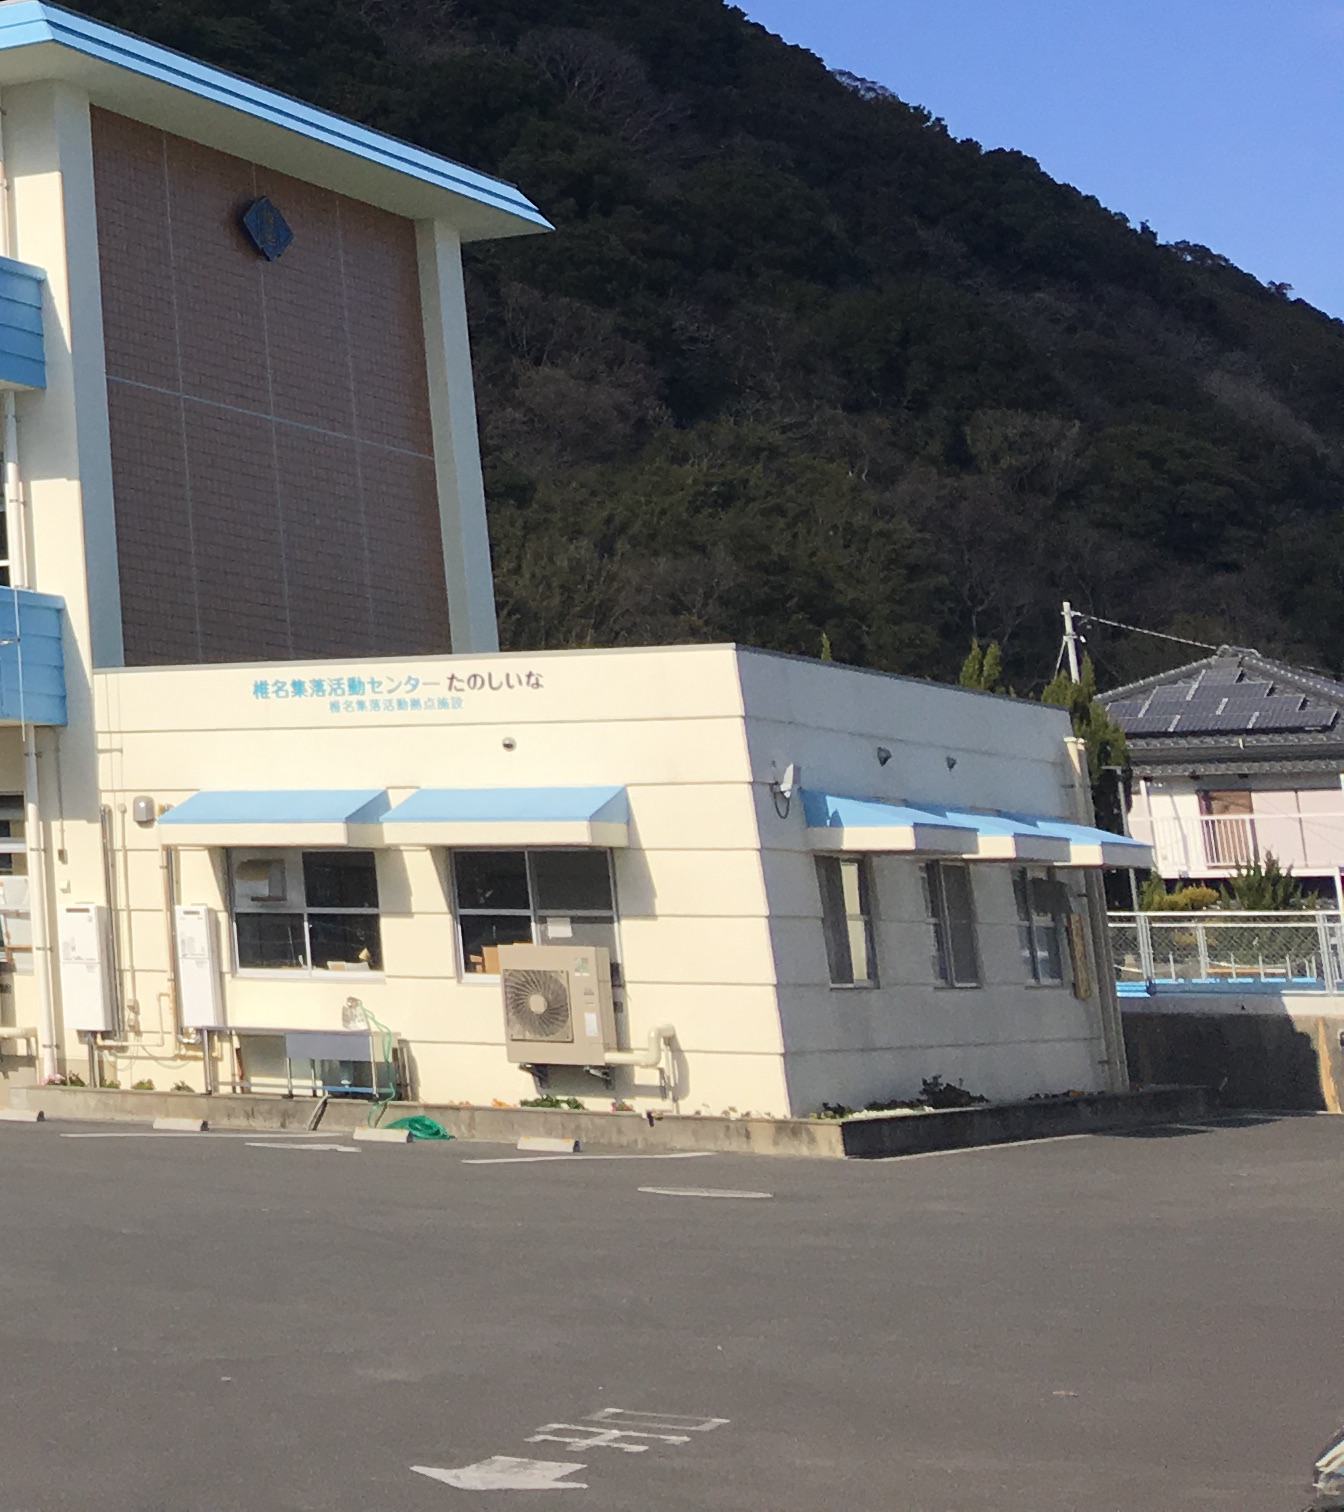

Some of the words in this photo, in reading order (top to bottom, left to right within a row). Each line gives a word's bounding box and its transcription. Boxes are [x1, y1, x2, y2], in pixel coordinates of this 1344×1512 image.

[252, 675, 440, 699] 椎名集落活動センター
[446, 670, 544, 693] たのしいな
